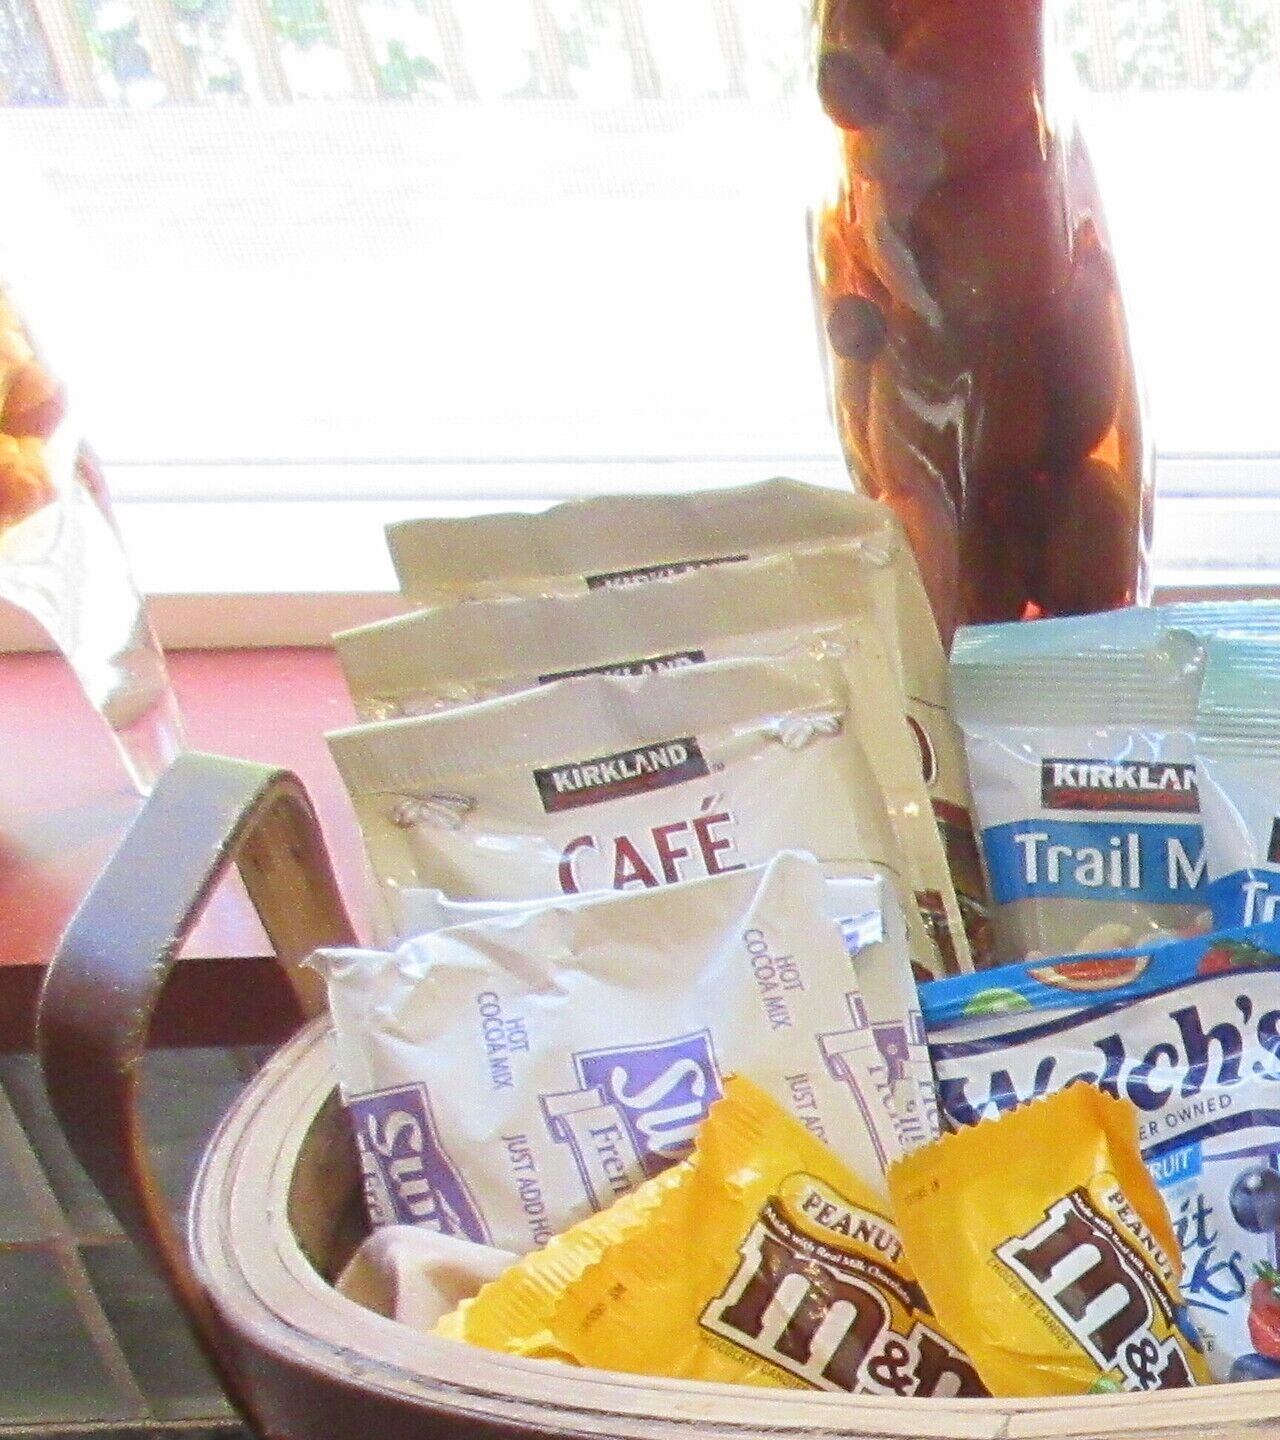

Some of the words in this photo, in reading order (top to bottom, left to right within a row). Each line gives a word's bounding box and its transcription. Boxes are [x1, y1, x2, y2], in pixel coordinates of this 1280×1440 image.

[552, 744, 688, 792] KIRKLAND
[1052, 762, 1199, 791] KIRKLAN
[558, 792, 747, 895] CAFÉ
[1014, 832, 1139, 890] Trail
[775, 955, 806, 992] HOT
[504, 1018, 530, 1051] HOT
[1165, 1093, 1234, 1127] OWNED
[1151, 1148, 1193, 1179] RUIT
[502, 1134, 537, 1172] JUST
[529, 1217, 553, 1246] HO
